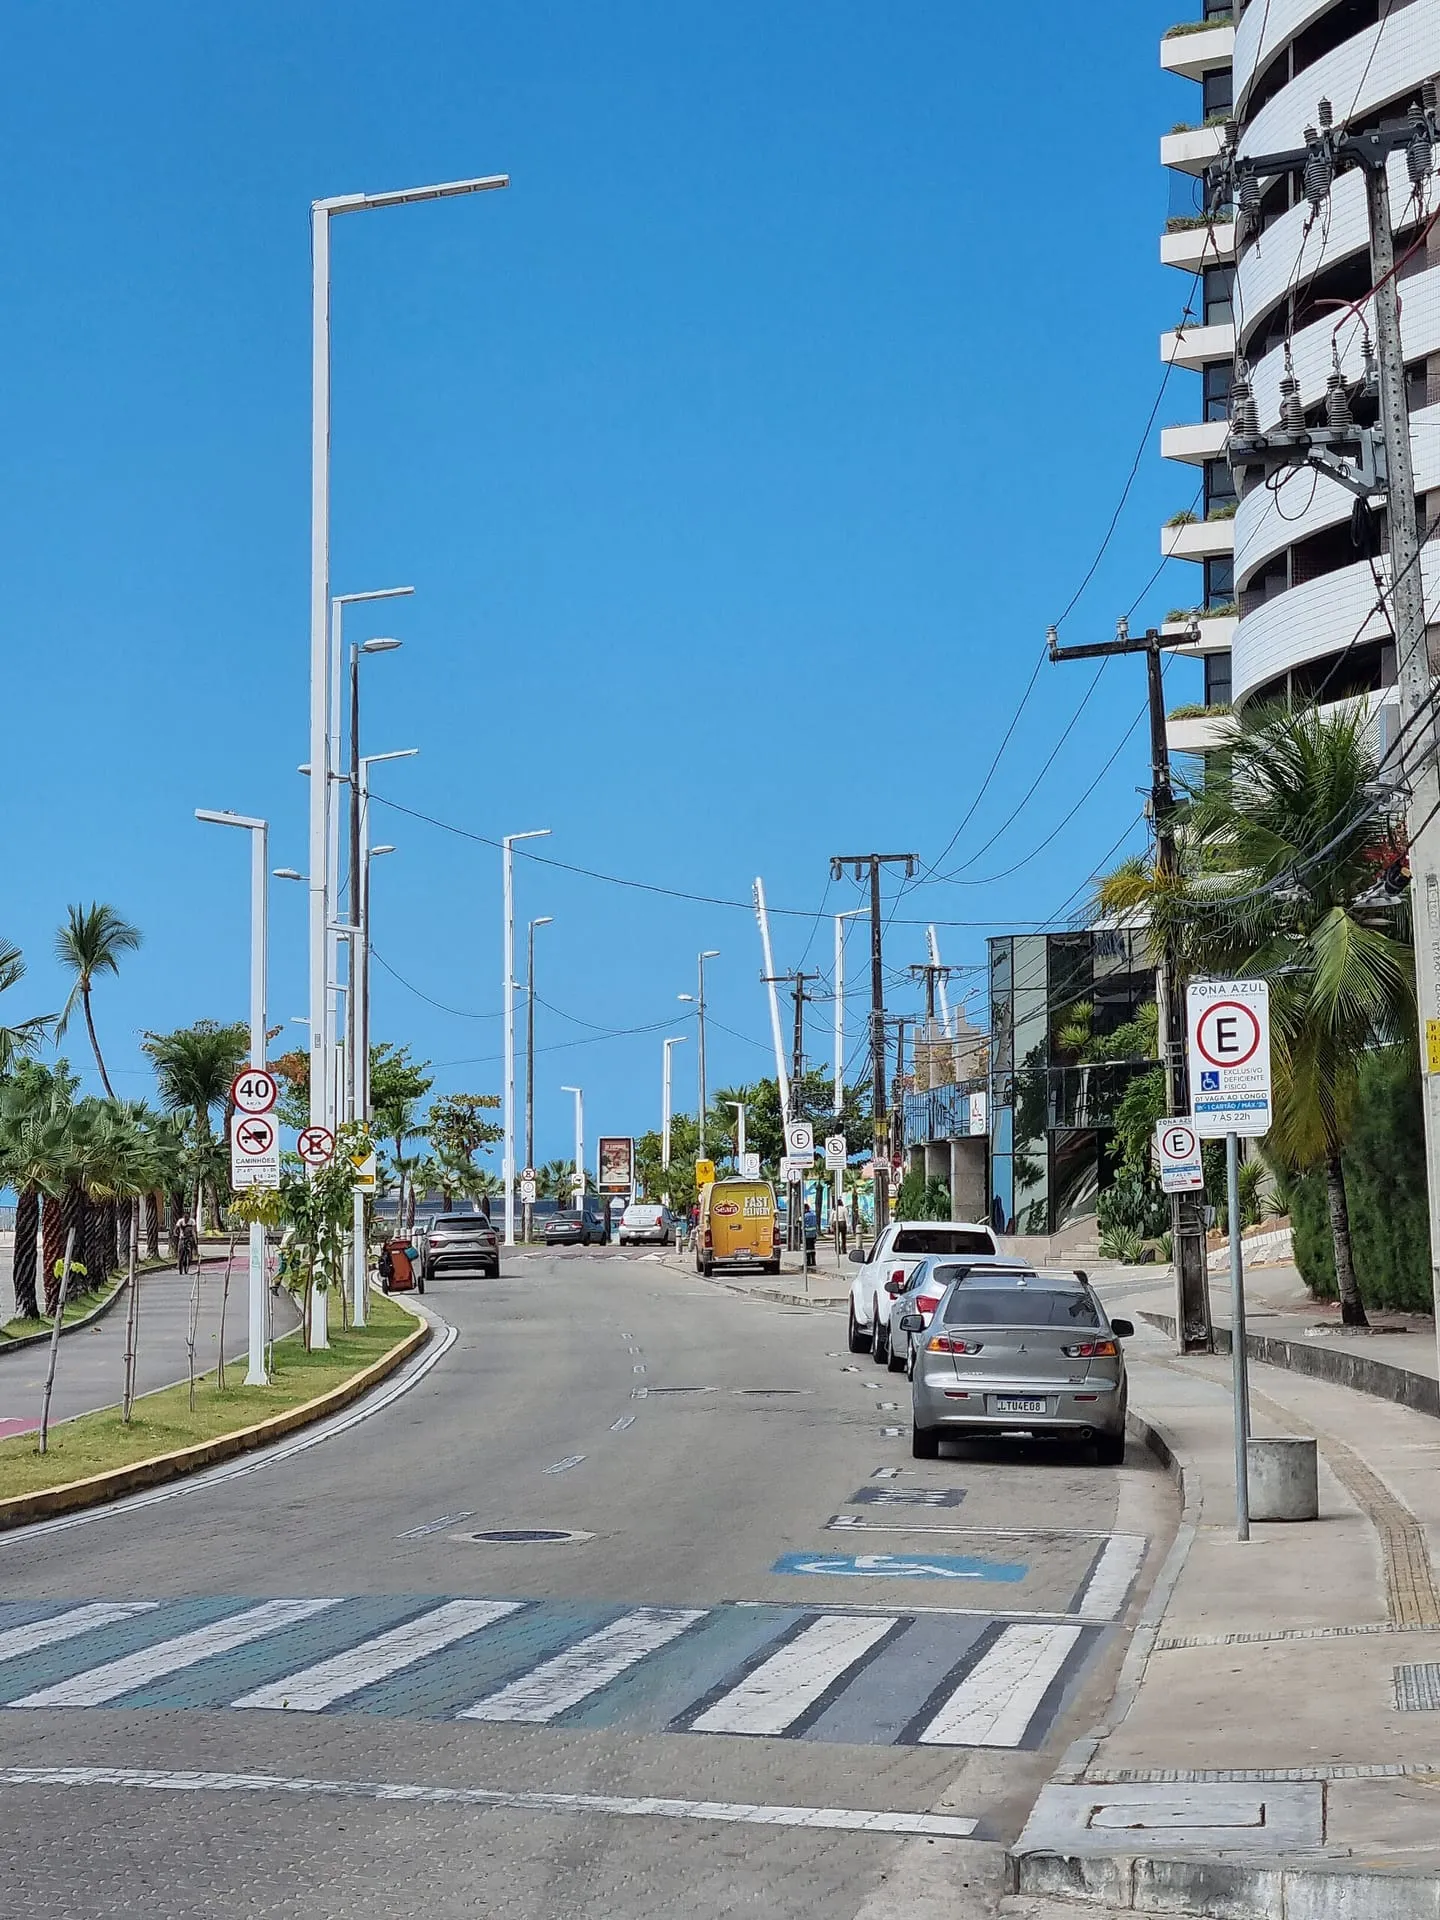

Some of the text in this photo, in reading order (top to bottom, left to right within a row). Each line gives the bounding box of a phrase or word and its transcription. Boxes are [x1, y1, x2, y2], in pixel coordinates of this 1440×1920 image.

[1191, 985, 1226, 996] ZONA
[1231, 983, 1265, 993] AZUL
[1216, 1017, 1239, 1053] E
[1223, 1067, 1262, 1076] EXCLUSIVO
[1224, 1075, 1265, 1083] DEFICIENTE
[240, 1079, 269, 1098] 40
[1234, 1112, 1251, 1121] 22h
[796, 1133, 803, 1145] E
[1172, 1134, 1185, 1152] E
[235, 1157, 276, 1165] CAMINHÕES
[744, 1196, 769, 1208] FAST
[743, 1207, 770, 1216] DELIVERY
